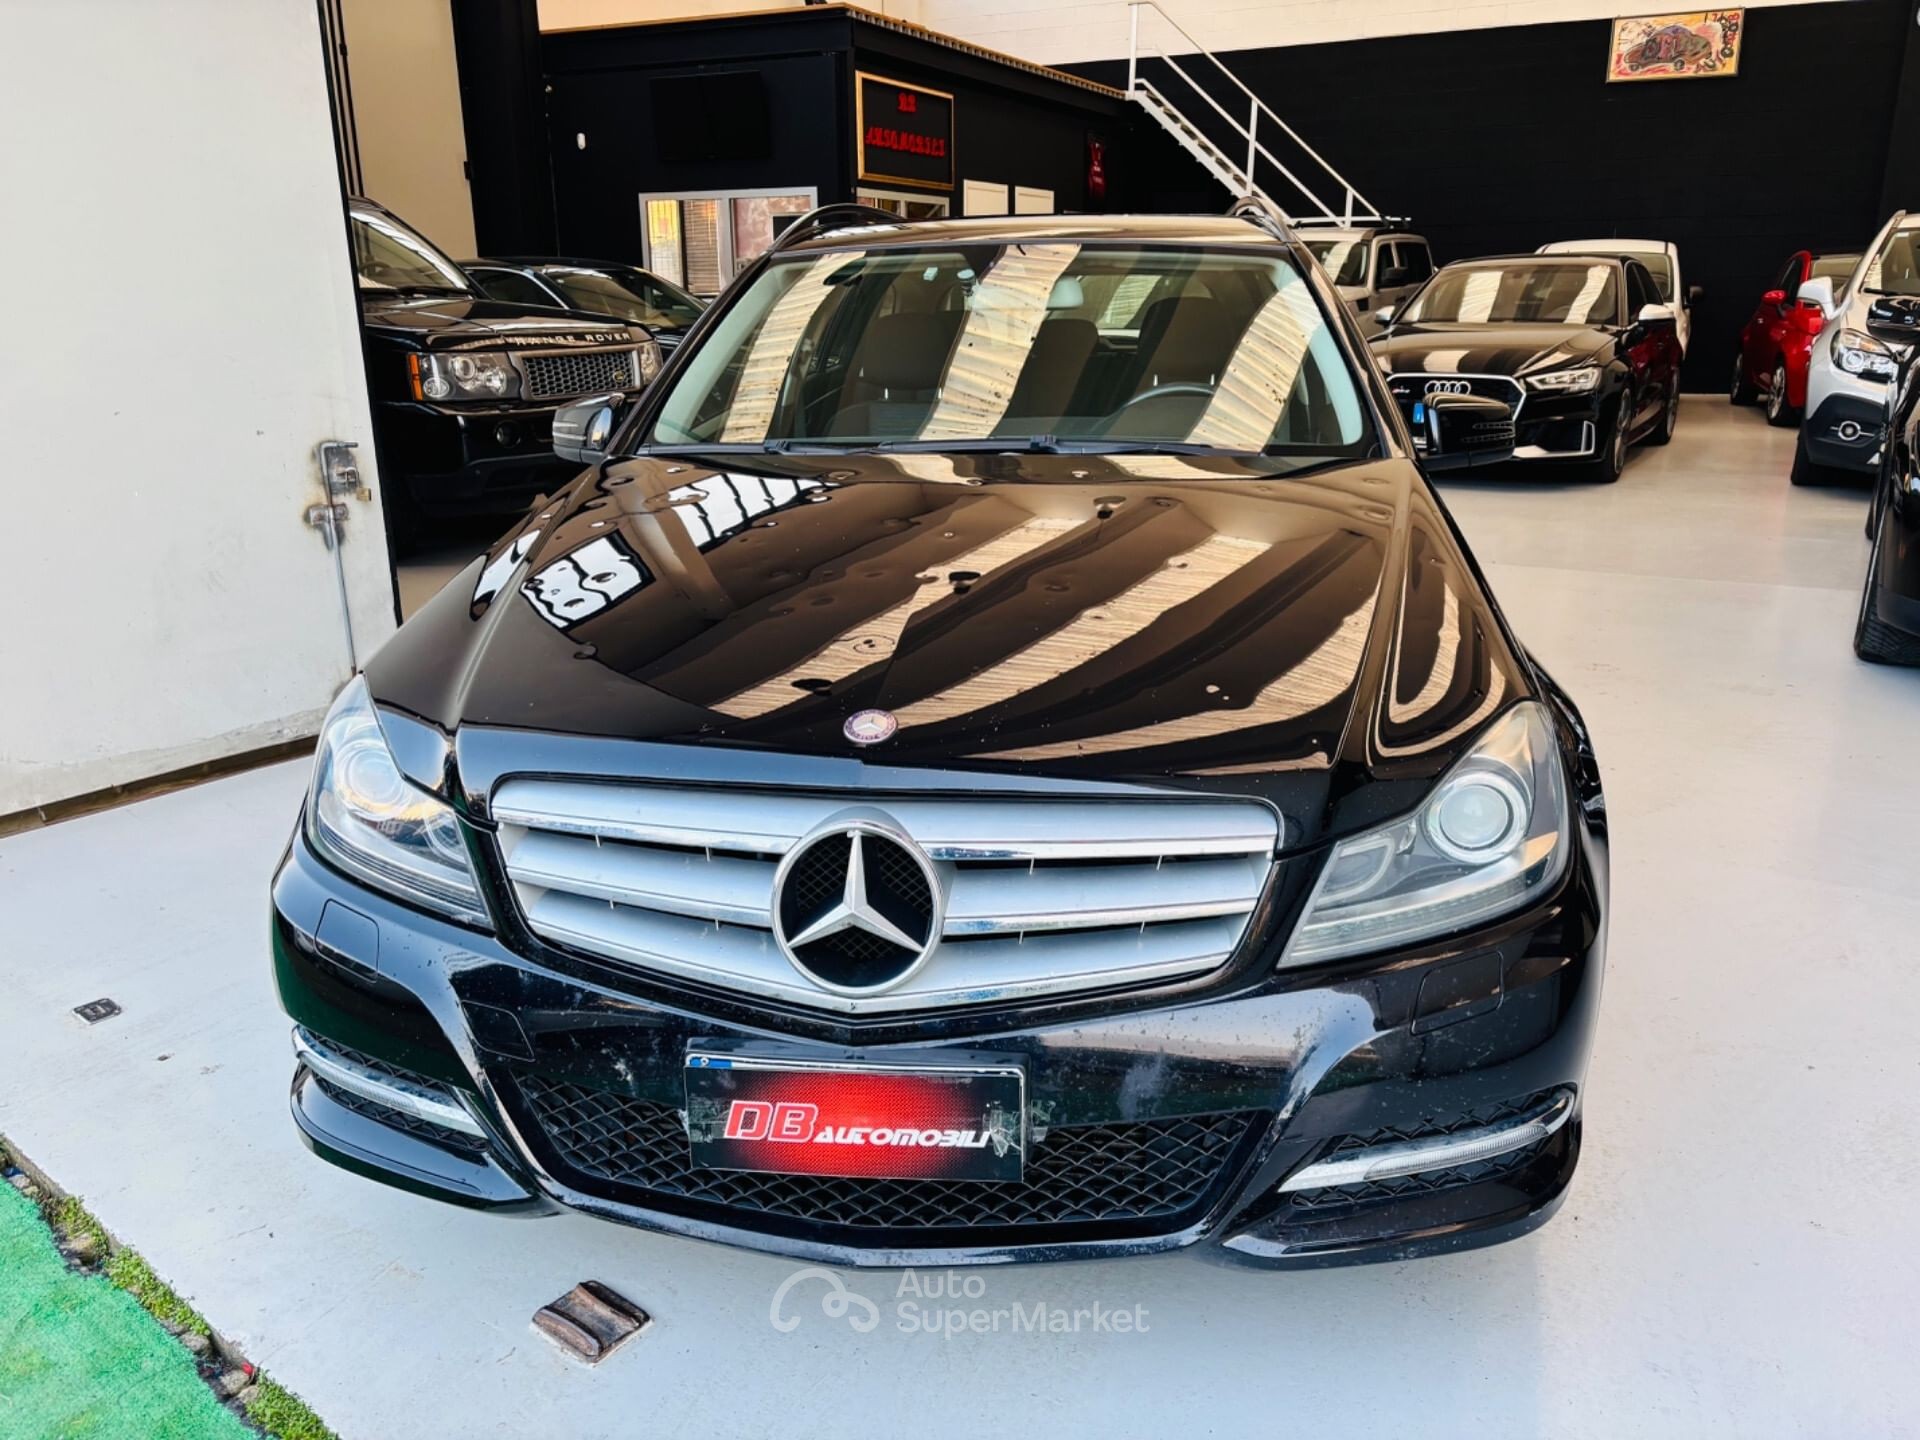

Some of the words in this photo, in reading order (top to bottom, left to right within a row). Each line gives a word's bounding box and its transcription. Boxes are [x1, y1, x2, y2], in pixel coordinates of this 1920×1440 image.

[515, 335, 576, 346] RANGE
[584, 332, 631, 342] ROVER
[724, 1100, 819, 1142] DB
